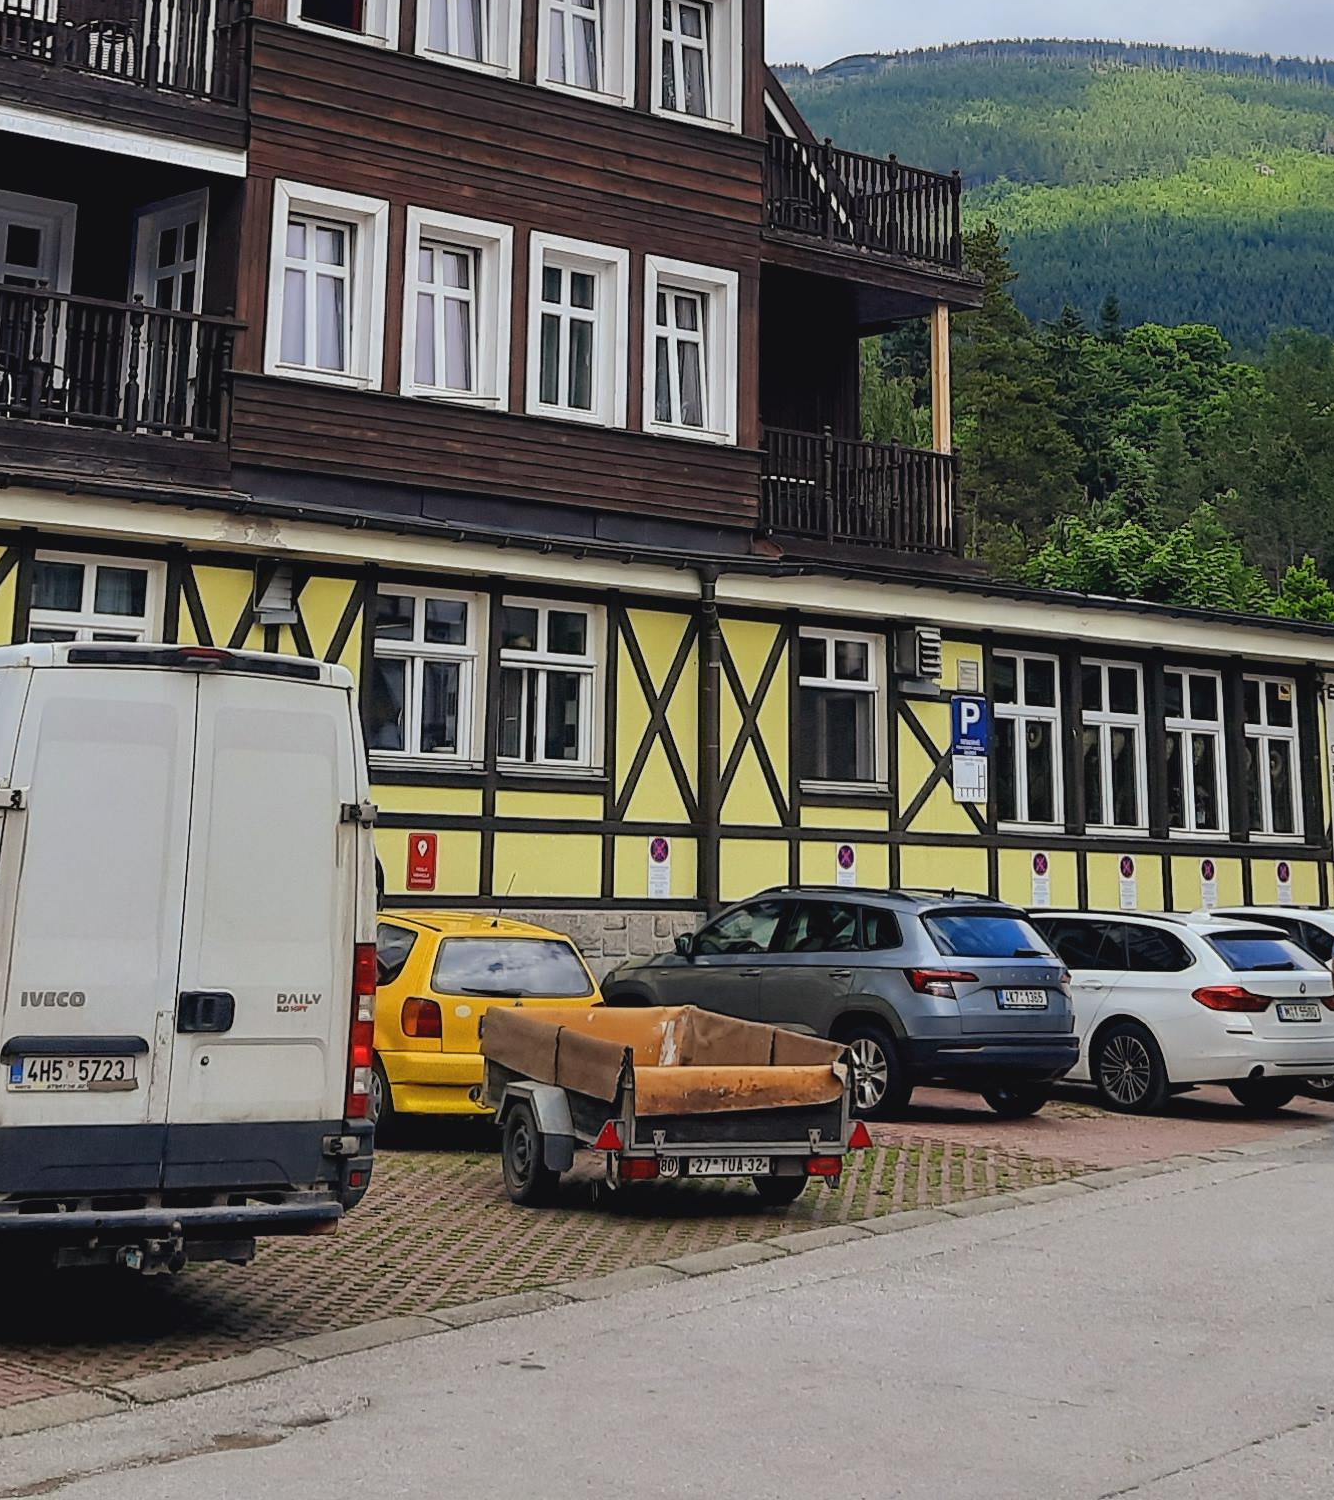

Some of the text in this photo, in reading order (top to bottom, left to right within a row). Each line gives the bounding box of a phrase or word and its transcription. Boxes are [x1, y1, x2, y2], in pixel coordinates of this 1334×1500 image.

[961, 702, 980, 734] P
[21, 991, 86, 1008] IVECO
[276, 993, 322, 1004] DAILY
[27, 1060, 125, 1082] 4H5 5723
[661, 1159, 675, 1172] 80
